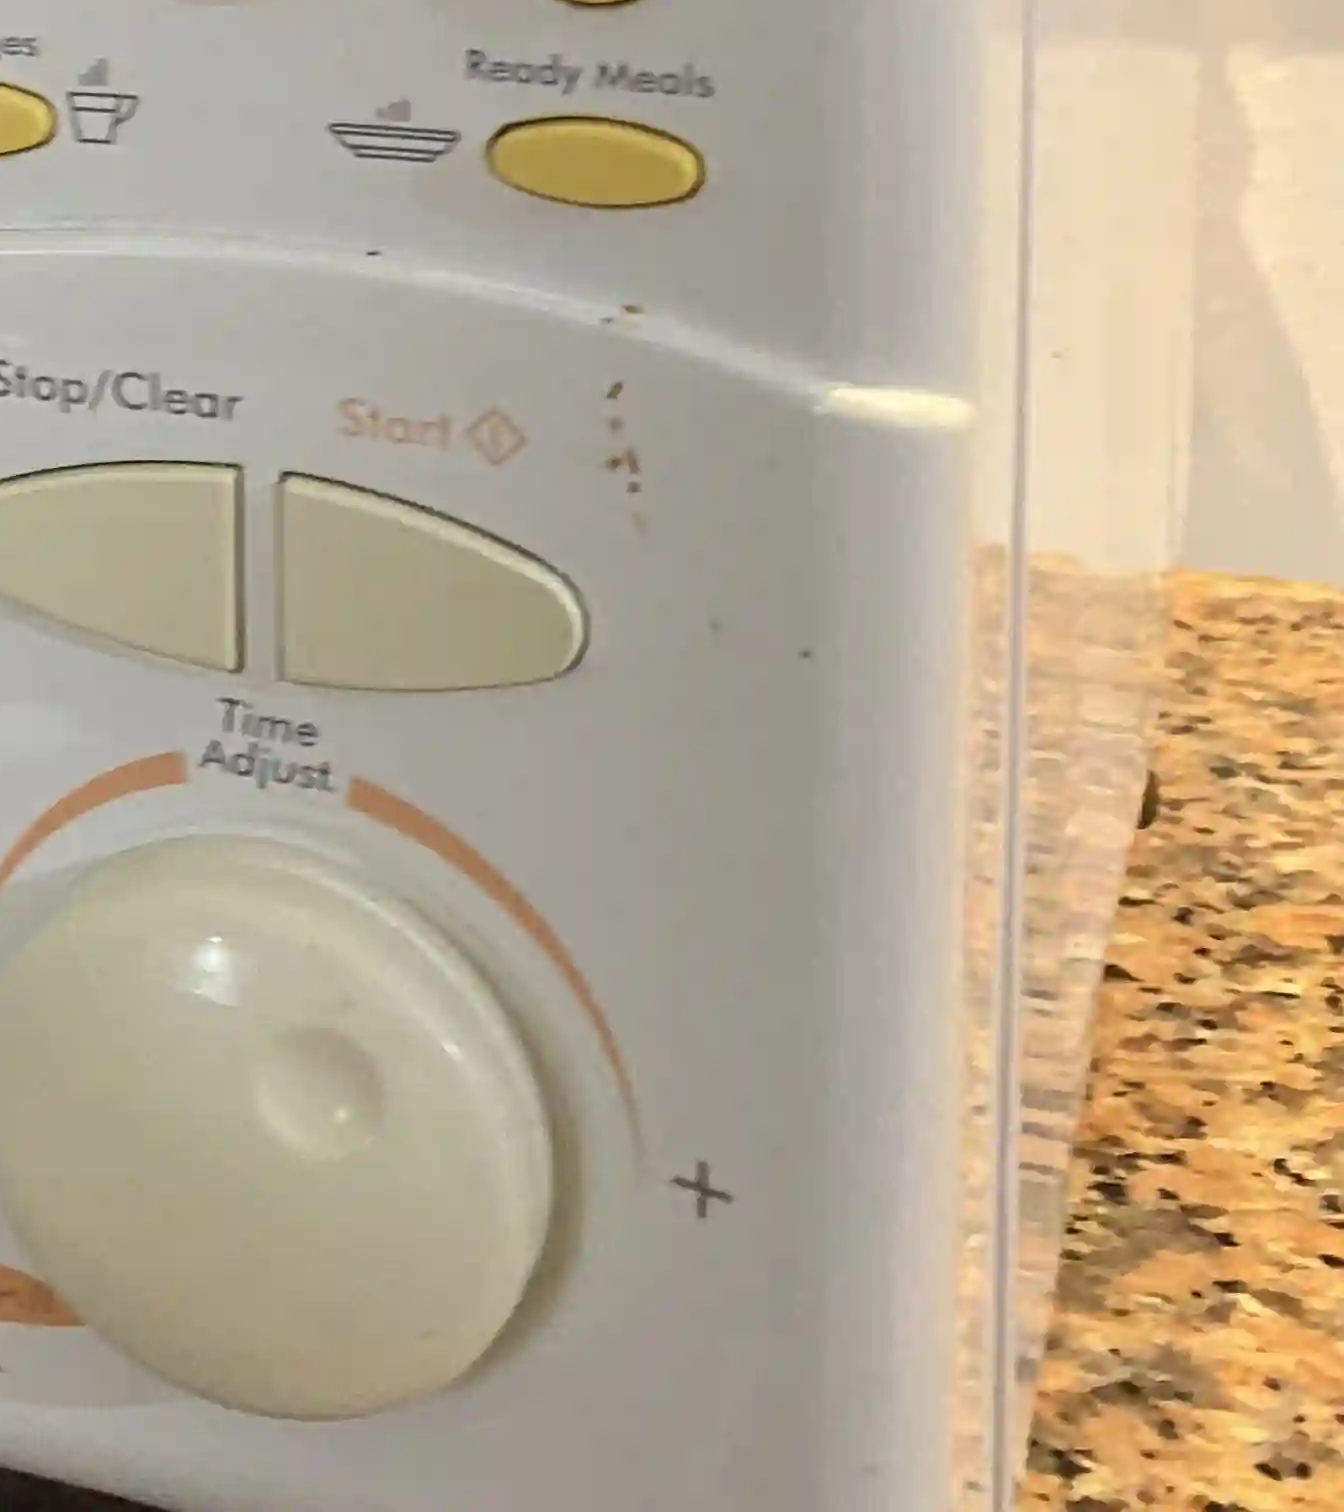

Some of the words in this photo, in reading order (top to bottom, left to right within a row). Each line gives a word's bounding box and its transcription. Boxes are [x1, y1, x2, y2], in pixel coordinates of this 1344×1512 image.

[464, 47, 585, 97] Ready
[594, 58, 716, 99] Meals
[337, 396, 452, 451] Start
[215, 696, 320, 747] Time
[197, 739, 339, 792] Adjust
